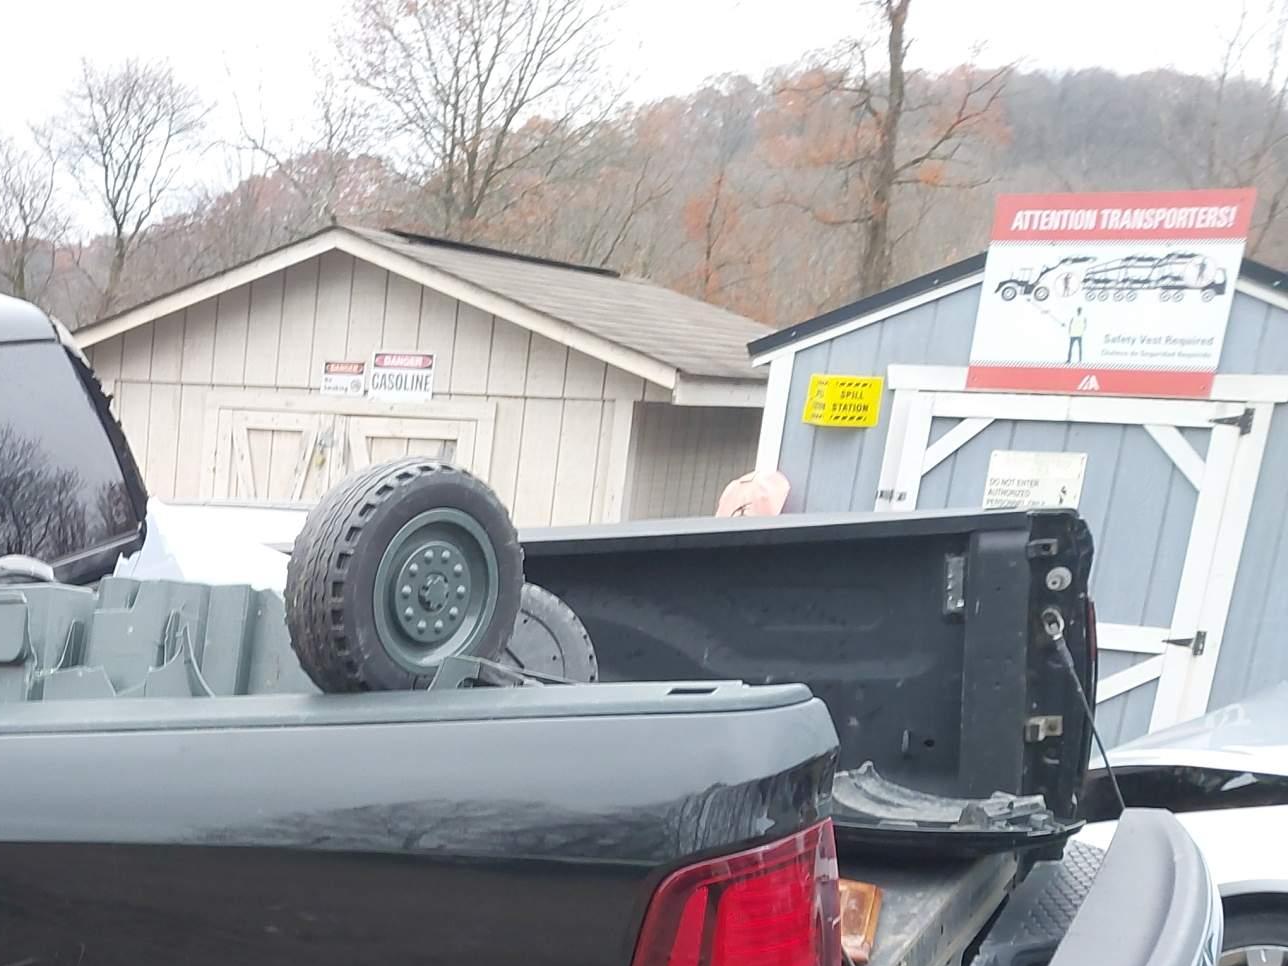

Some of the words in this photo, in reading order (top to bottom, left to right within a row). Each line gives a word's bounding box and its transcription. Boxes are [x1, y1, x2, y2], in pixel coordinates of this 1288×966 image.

[1011, 209, 1098, 231] ATTENTION
[1100, 206, 1238, 230] TRANSPORTERS!
[1104, 333, 1137, 346] Safety
[1139, 335, 1164, 346] Vest
[1165, 335, 1215, 347] Required
[383, 355, 423, 368] DANGER
[372, 373, 431, 393] GASOLINE
[840, 390, 865, 400] SPILL
[832, 403, 869, 412] STATION
[989, 478, 1001, 487] DO
[1001, 478, 1016, 488] NOT
[1017, 479, 1040, 488] ENTER
[987, 488, 1032, 497] AUTHORIZED
